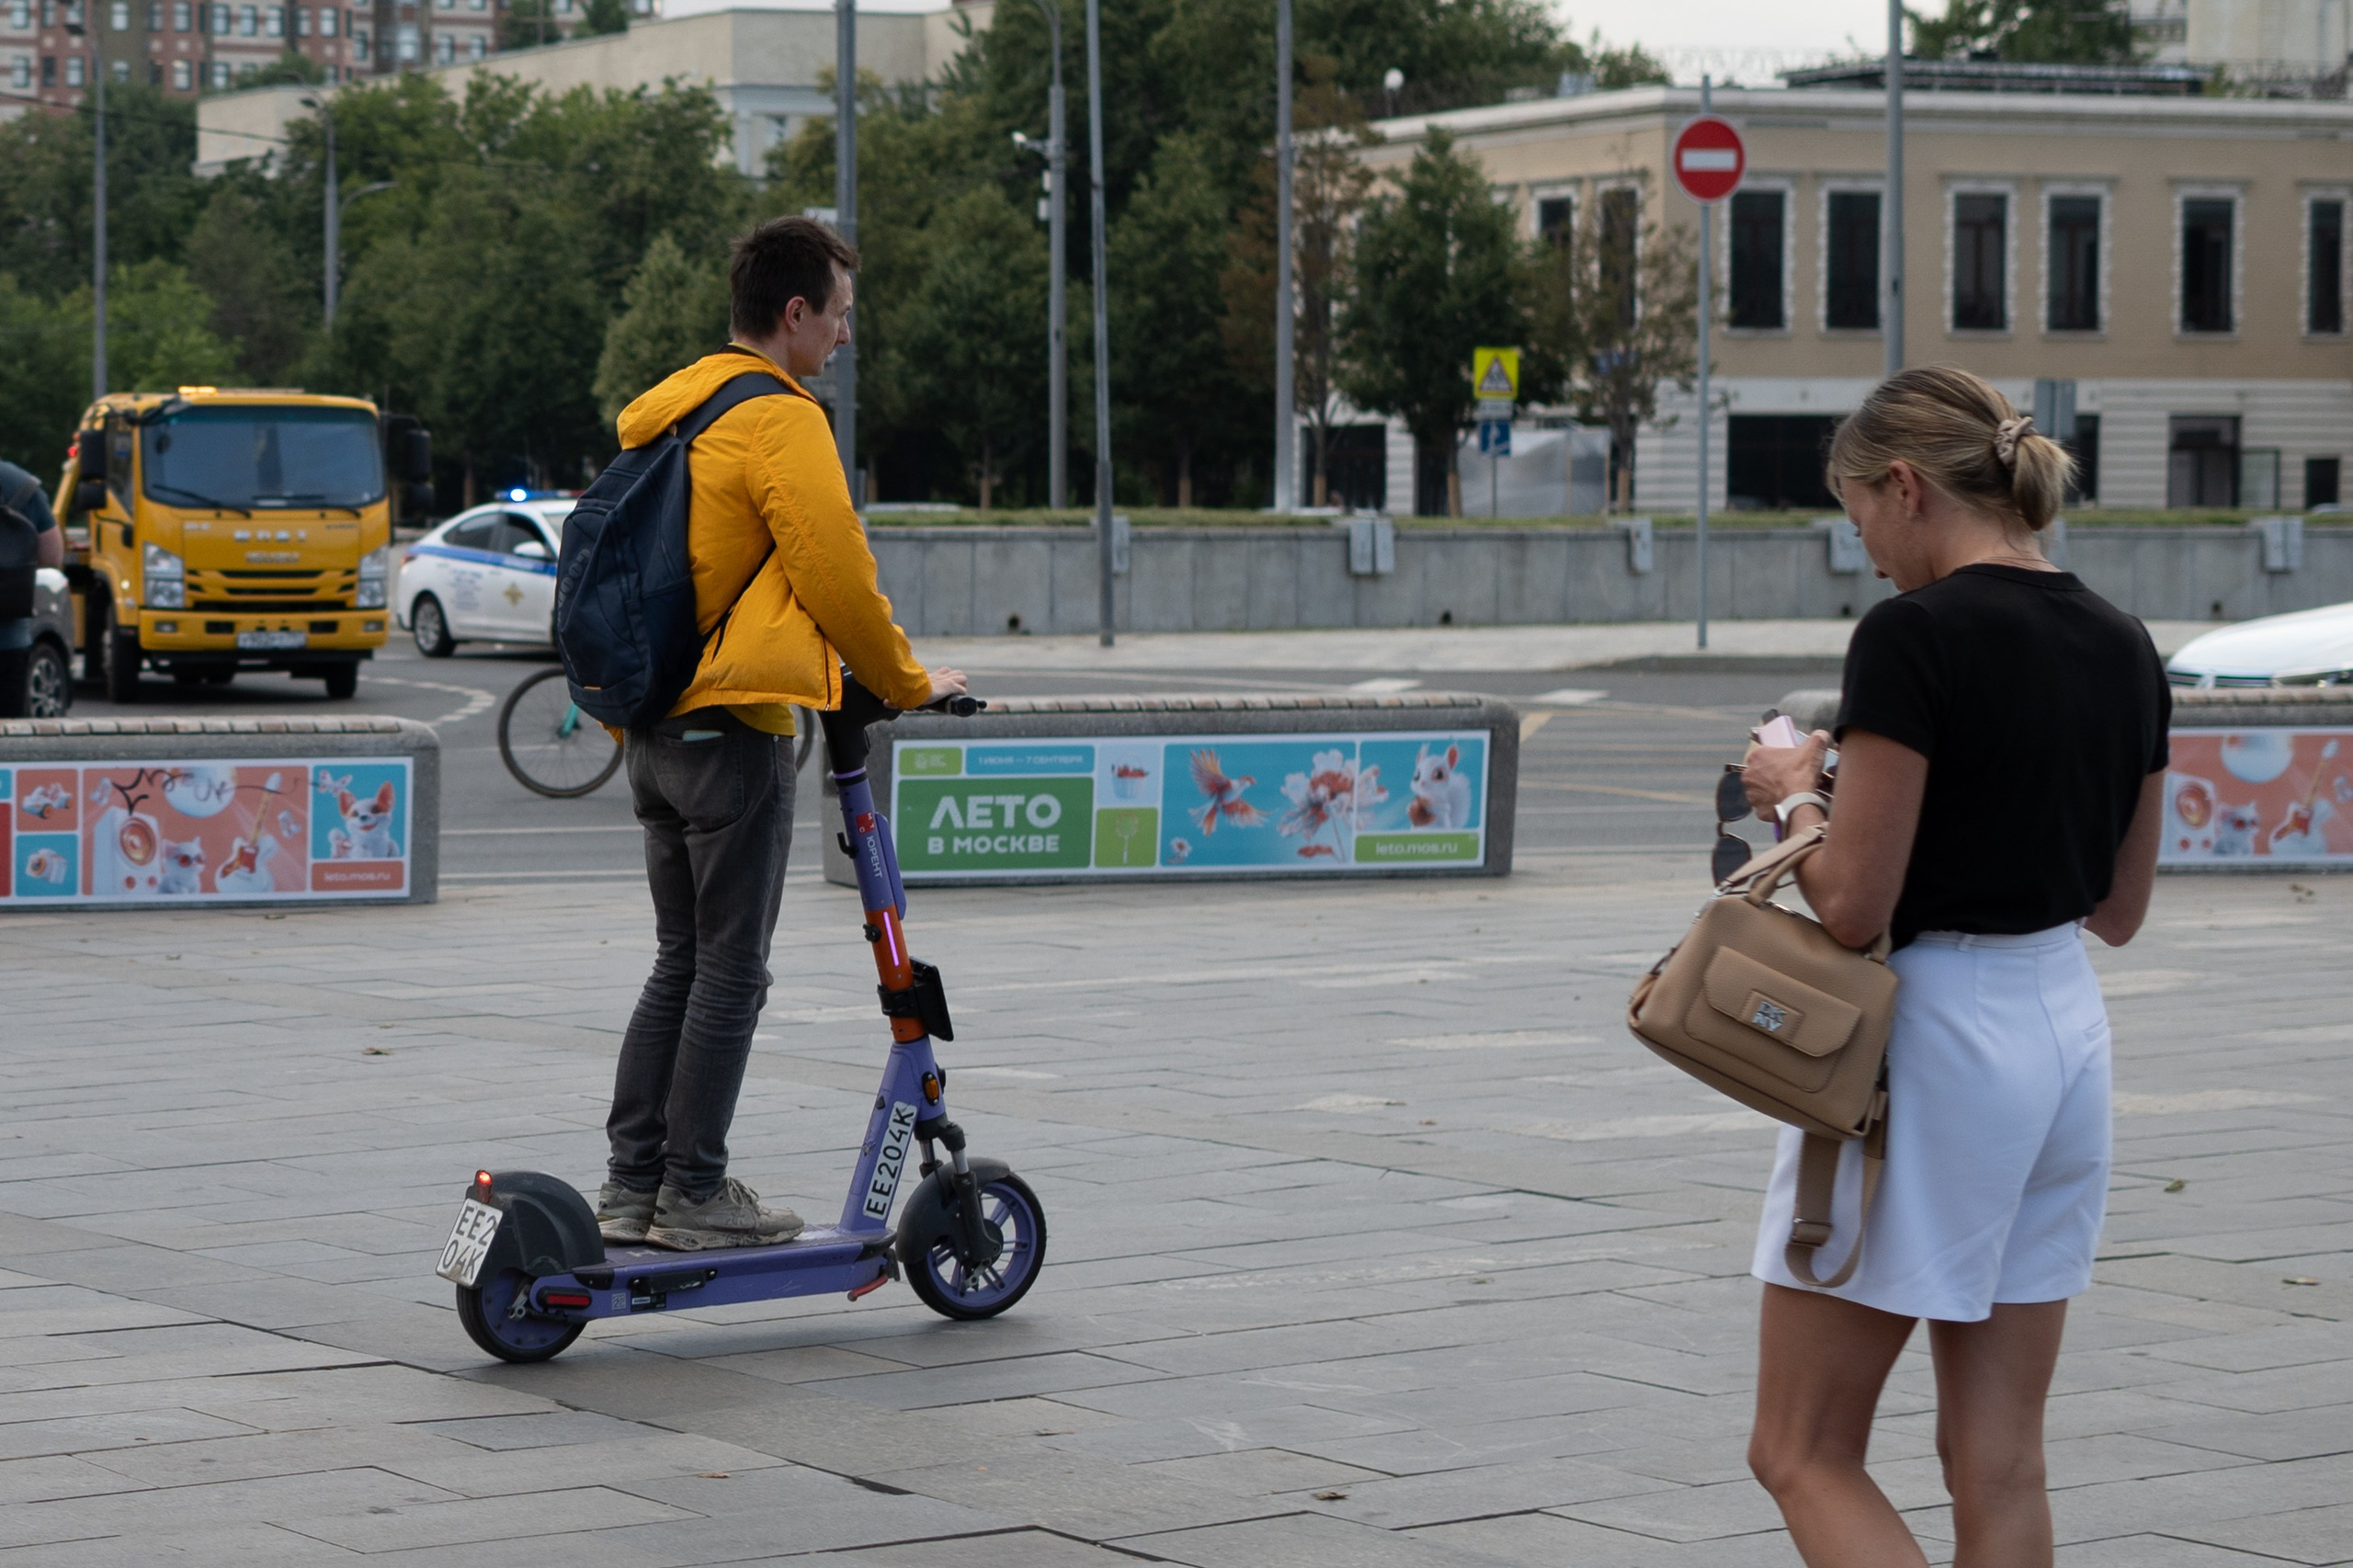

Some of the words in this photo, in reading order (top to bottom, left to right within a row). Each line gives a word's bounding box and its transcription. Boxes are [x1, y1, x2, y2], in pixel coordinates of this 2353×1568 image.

[928, 793, 1062, 829] ЛЕТО
[866, 835, 882, 878] ЮРЕНТ
[927, 836, 944, 855] В
[952, 835, 1060, 855] МОСКВЕ
[1375, 842, 1458, 855] leto.mos.ru
